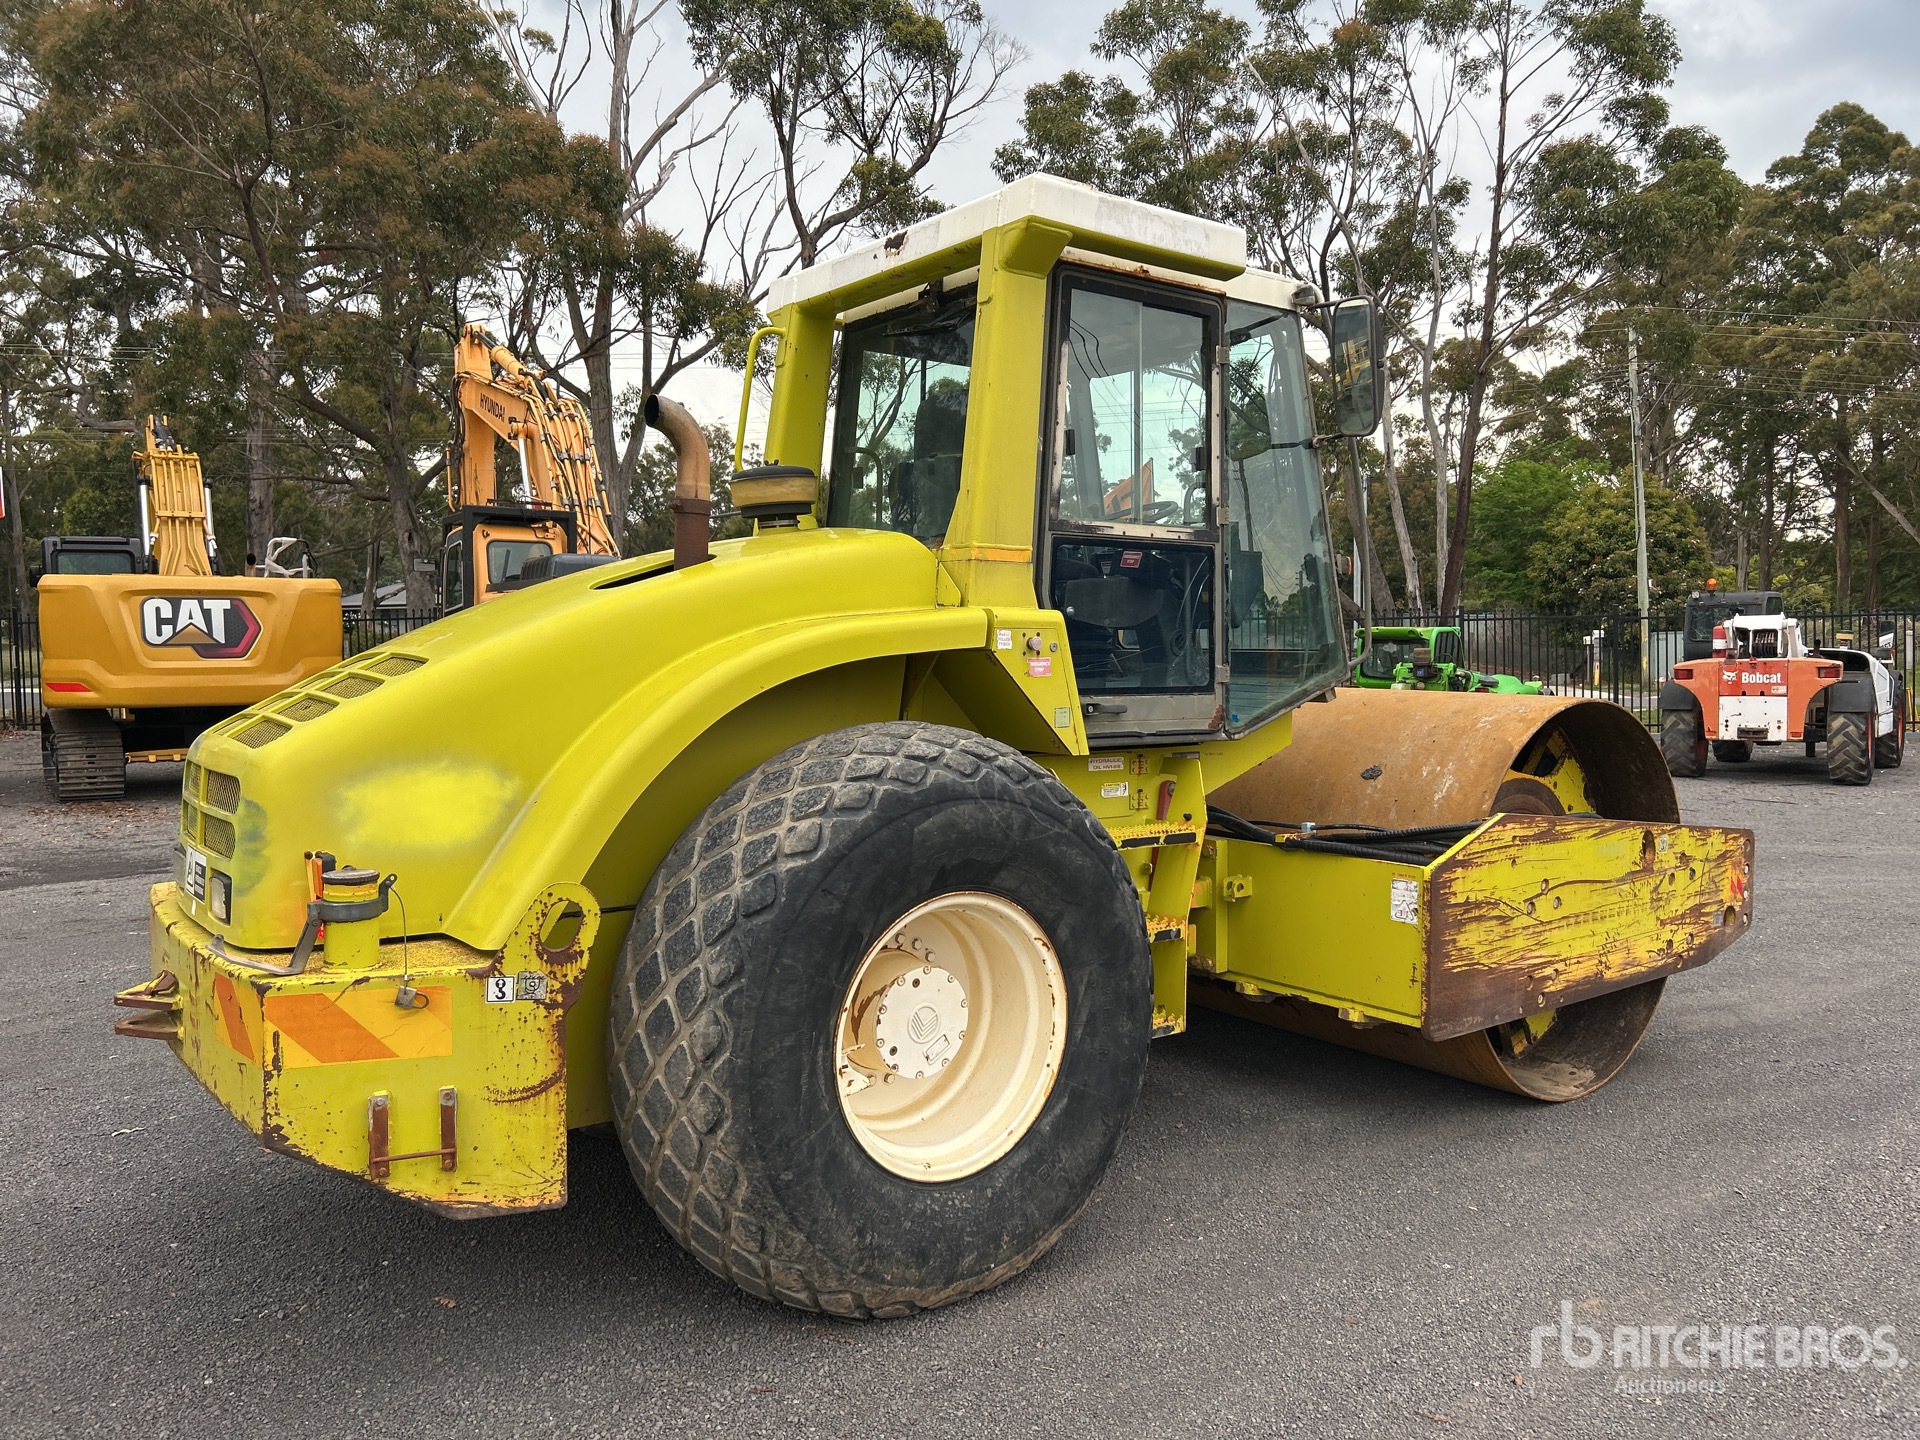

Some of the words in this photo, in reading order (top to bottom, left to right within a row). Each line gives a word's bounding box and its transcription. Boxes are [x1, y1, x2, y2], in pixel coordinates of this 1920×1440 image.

[480, 393, 506, 422] HYUNDAI
[143, 598, 231, 645] CAT
[1741, 672, 1781, 683] Bobcat
